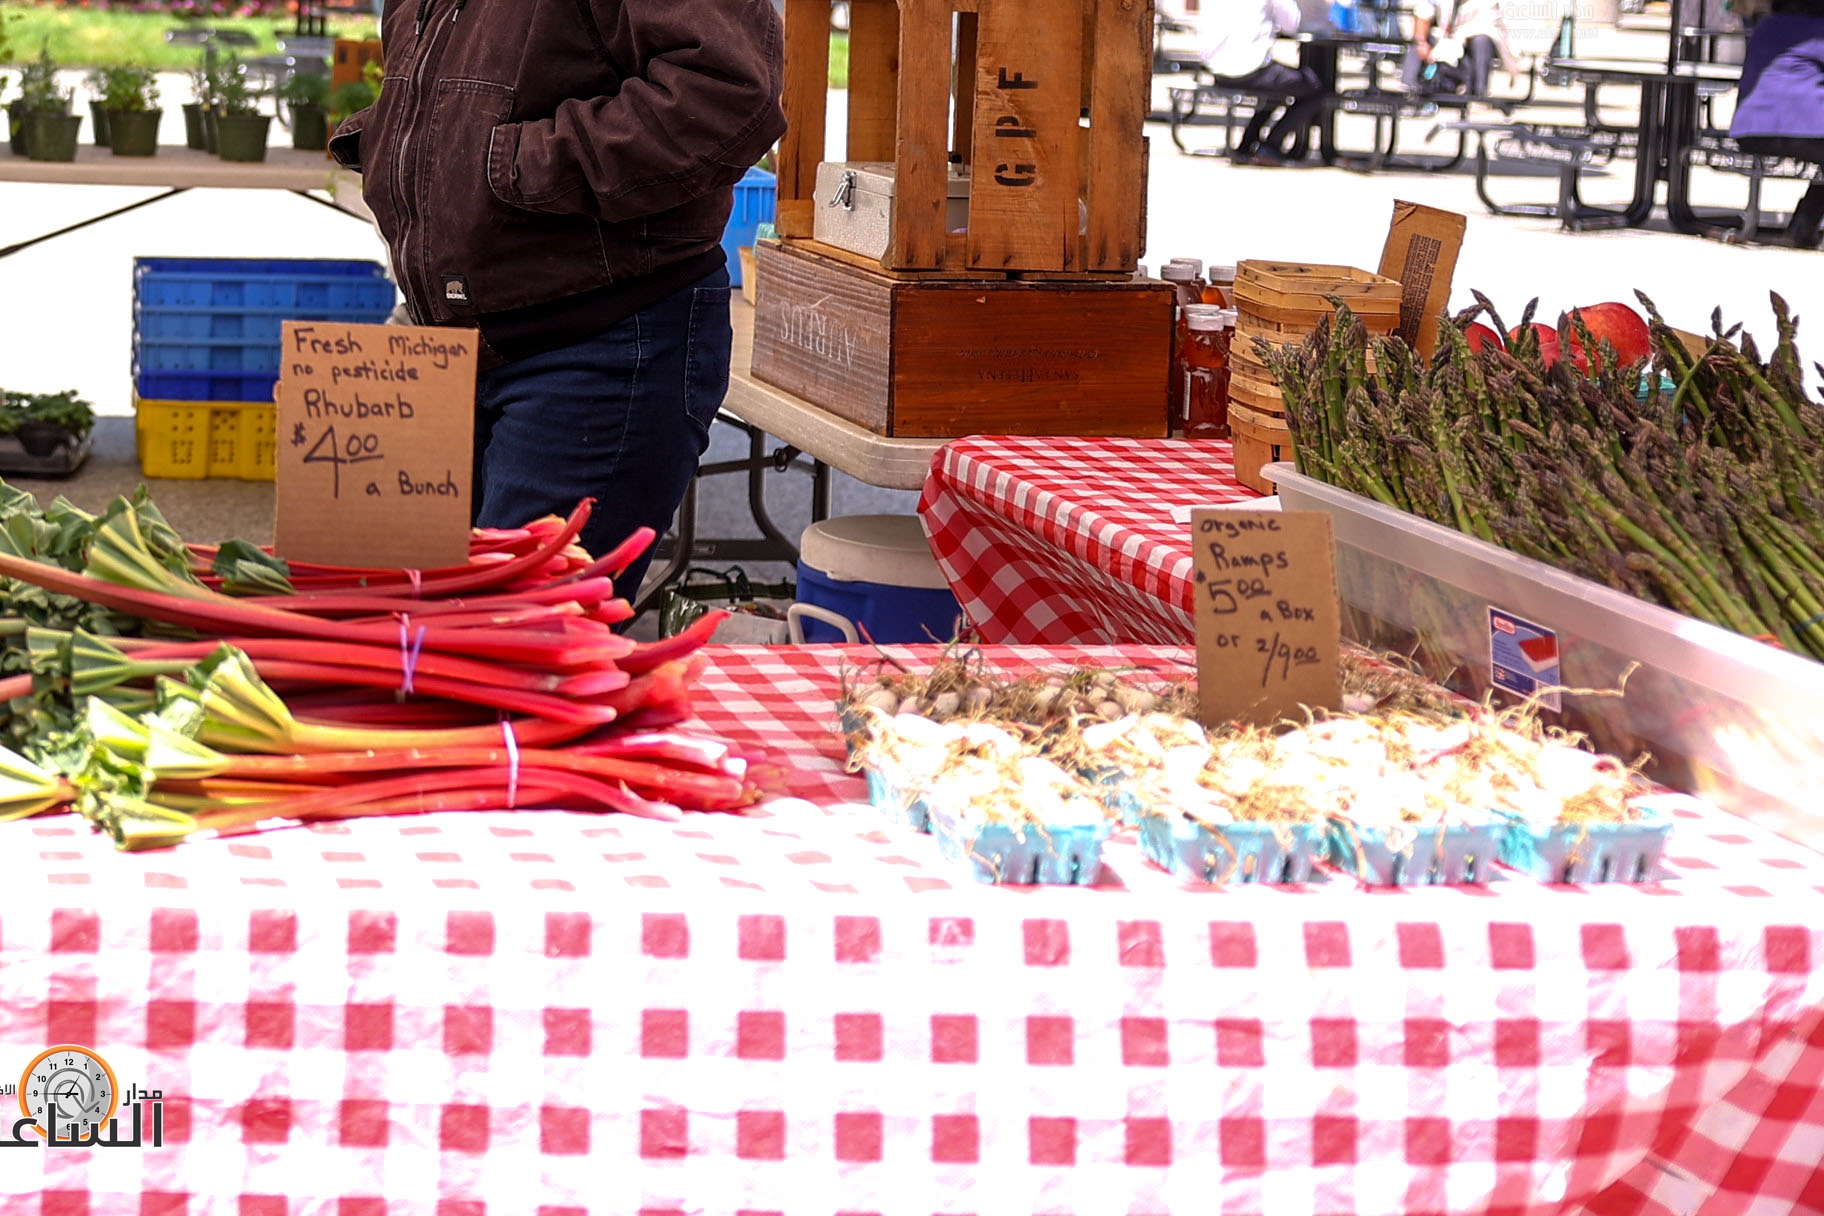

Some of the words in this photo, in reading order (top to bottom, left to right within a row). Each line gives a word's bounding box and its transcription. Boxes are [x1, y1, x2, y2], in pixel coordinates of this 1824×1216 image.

[293, 327, 363, 355] Fresh
[388, 334, 469, 370] Michigan
[292, 362, 314, 377] no
[332, 359, 420, 384] pesticide
[303, 387, 415, 420] Rhubarb
[365, 484, 382, 497] a
[397, 469, 459, 499] Bunch
[1209, 542, 1289, 577] Ramps
[1260, 609, 1274, 623] a
[1277, 600, 1315, 622] Box
[1216, 634, 1241, 648] or
